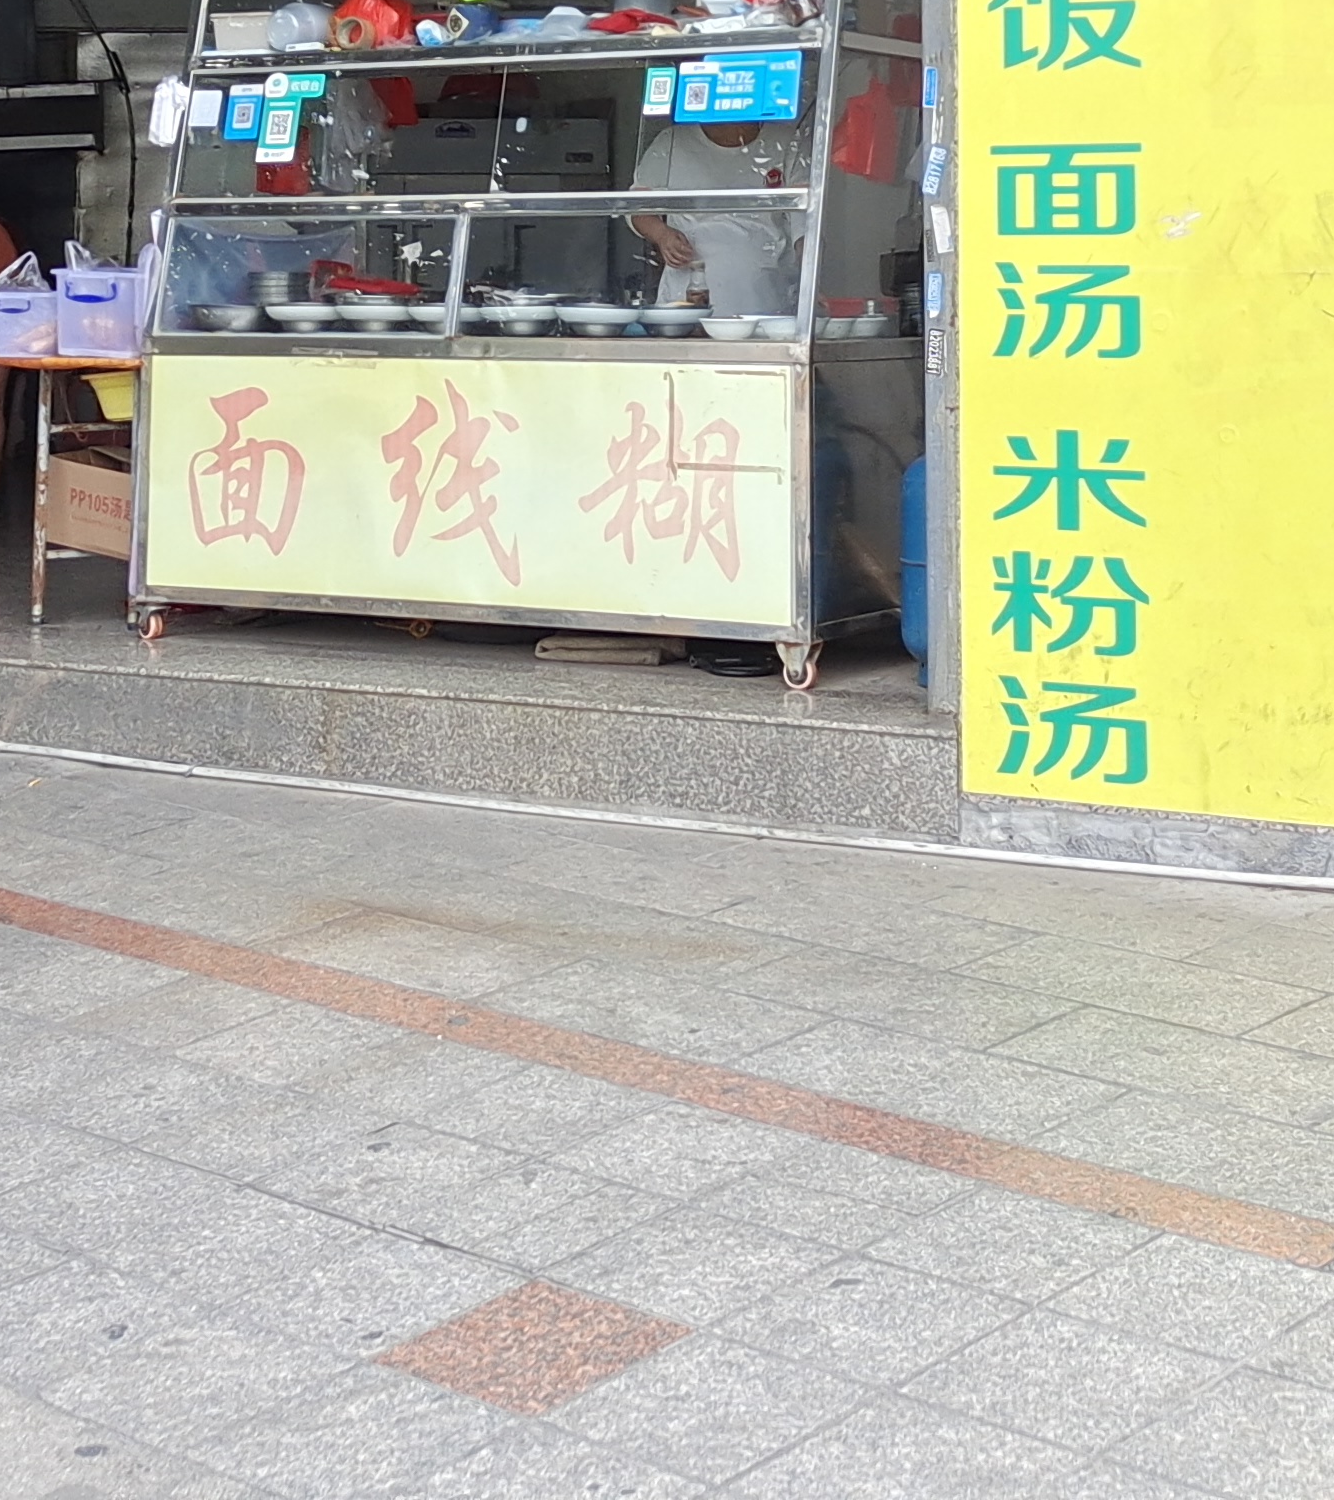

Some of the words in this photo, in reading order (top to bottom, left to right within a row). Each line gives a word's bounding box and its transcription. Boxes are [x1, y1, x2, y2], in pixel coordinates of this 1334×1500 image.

[990, 141, 1143, 360] 面汤
[187, 378, 743, 587] 面线糊
[991, 429, 1150, 785] 米粉汤
